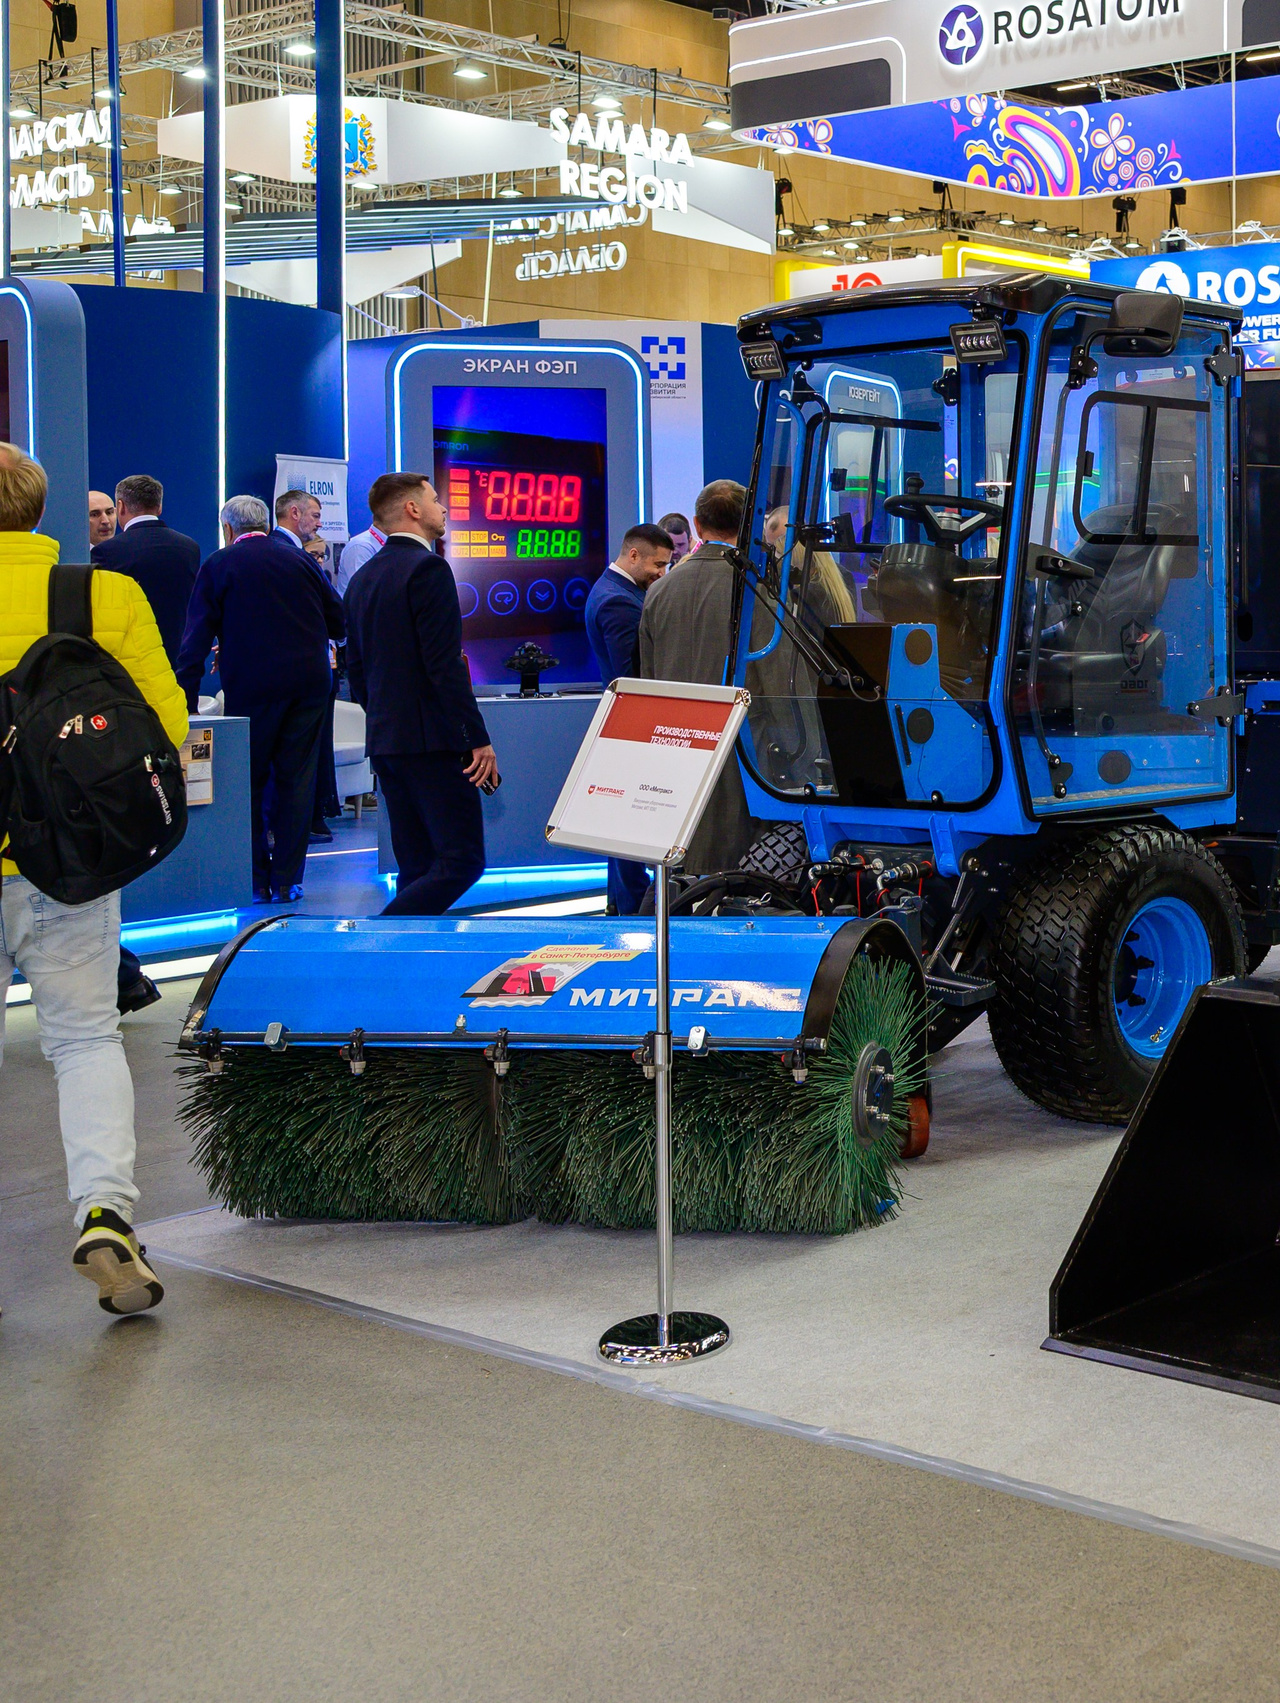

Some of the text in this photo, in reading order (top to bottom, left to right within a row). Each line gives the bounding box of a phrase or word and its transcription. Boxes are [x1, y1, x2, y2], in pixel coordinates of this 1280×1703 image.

[10, 106, 112, 160] АРСКАЯ
[550, 107, 694, 168] SAMARA
[10, 163, 95, 207] ЛАСТЬ
[560, 160, 688, 213] REGION
[463, 358, 577, 374] ЭКРАН ФЭП
[848, 385, 880, 403] ЮЗЕРГЕЙТ
[309, 480, 334, 496] ELRON
[472, 532, 488, 541] STOP
[653, 725, 723, 741] ПРОИЗВОДСТВЕННЫЕ
[650, 735, 692, 748] ТЕХНОЛОГИИ
[596, 786, 625, 796] МИТРАКС
[639, 783, 673, 794] ООО «Митракс»
[539, 951, 631, 961] Санкт-Петербурге
[568, 988, 802, 1008] МИТРАКС
